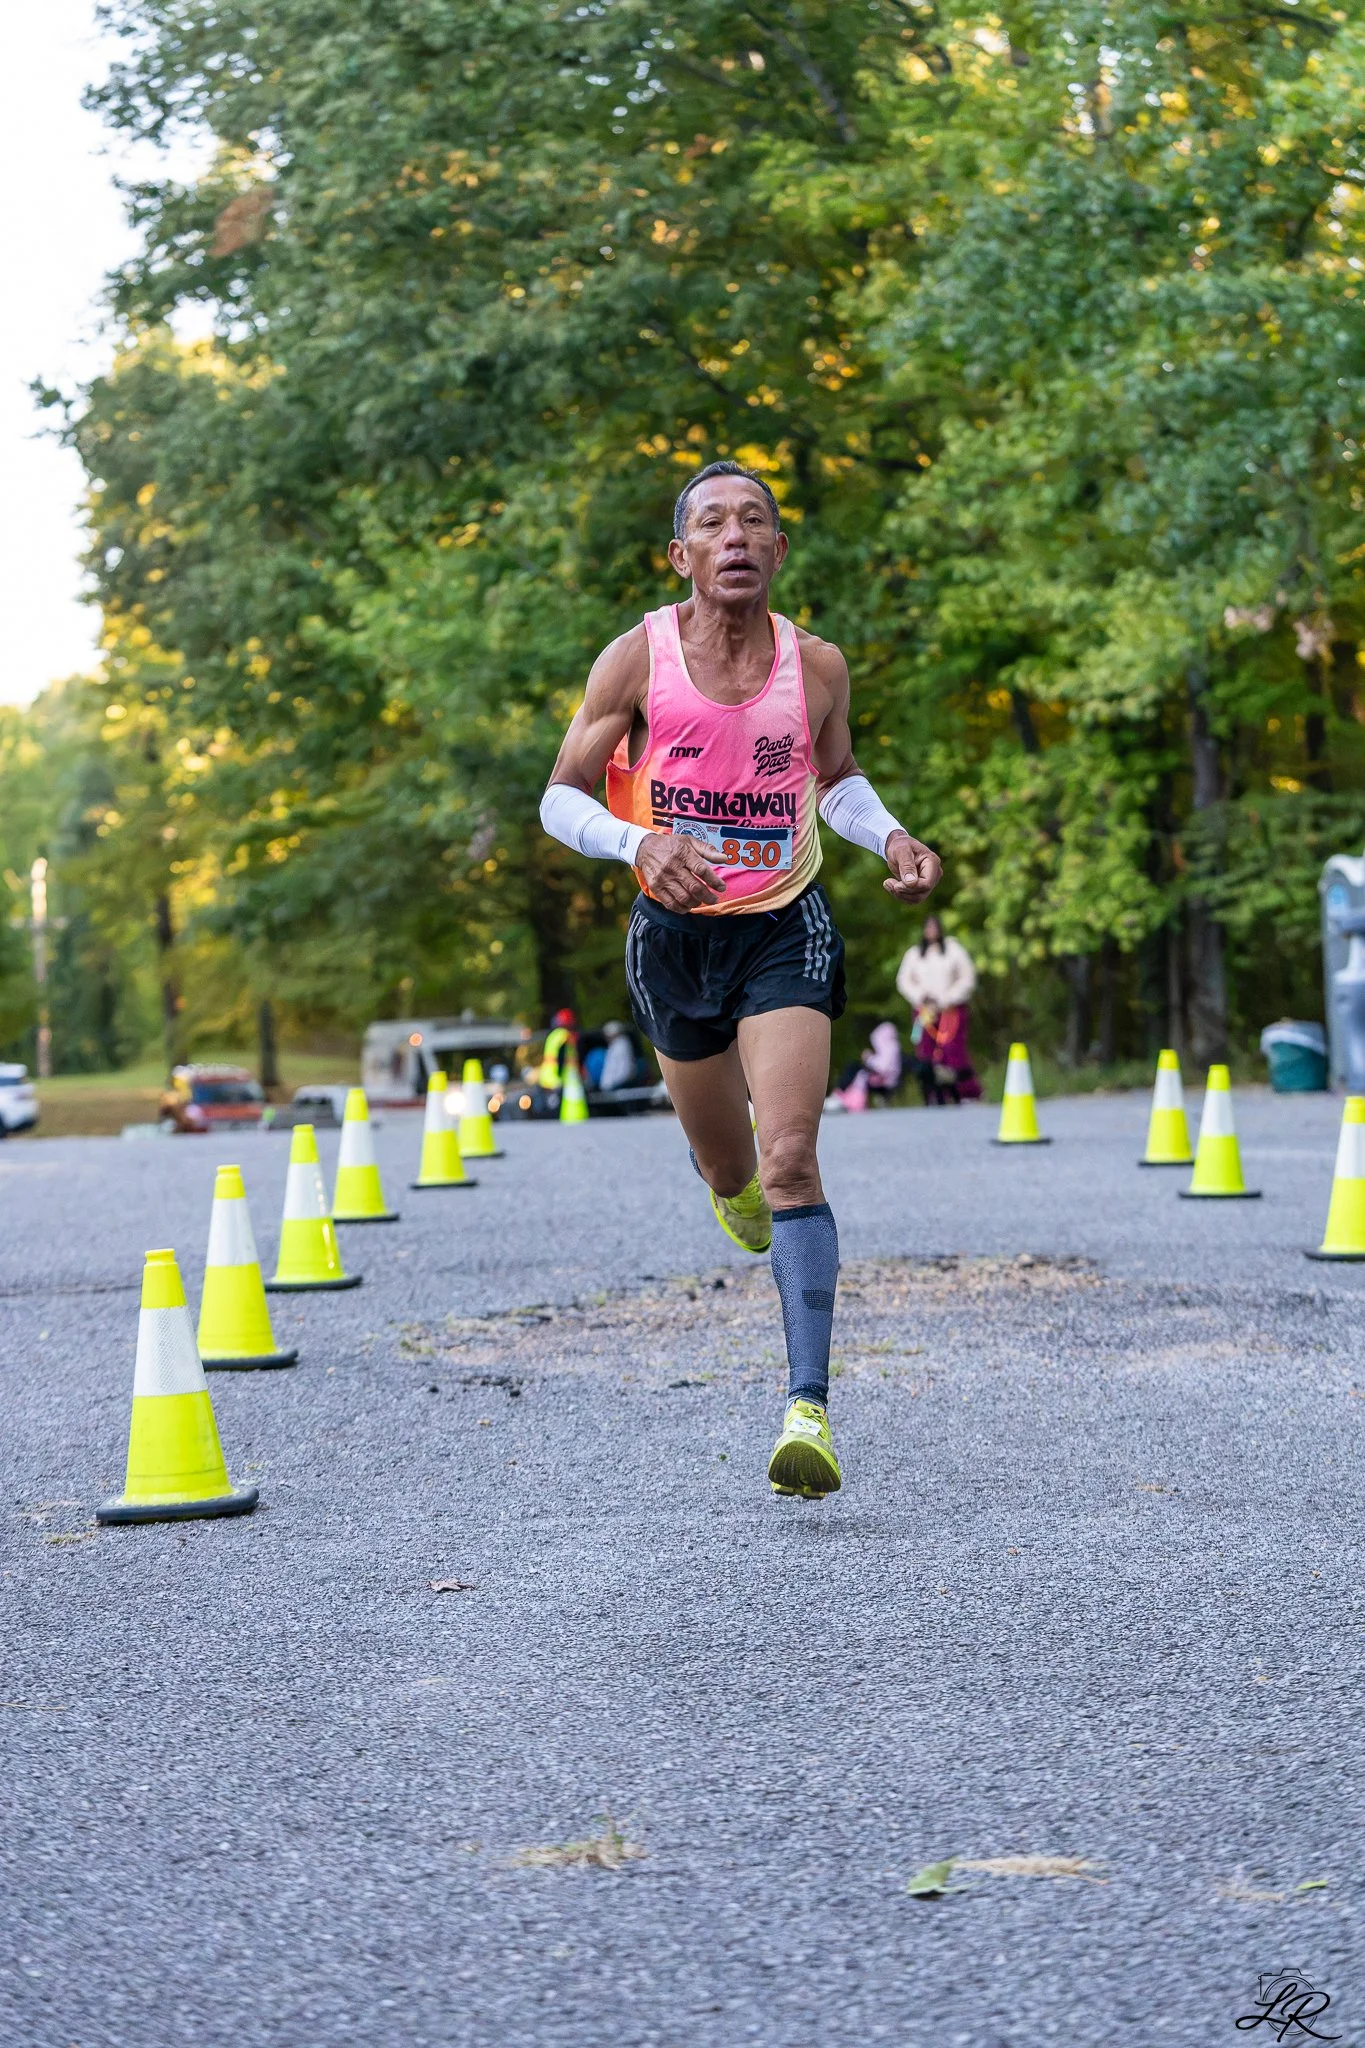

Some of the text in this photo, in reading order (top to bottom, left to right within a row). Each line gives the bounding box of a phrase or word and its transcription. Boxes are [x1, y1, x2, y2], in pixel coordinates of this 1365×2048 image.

[669, 746, 704, 758] rnnr
[753, 733, 794, 760] Party
[754, 754, 791, 776] Pace
[651, 779, 796, 823] Breakaway
[721, 839, 781, 868] 830
